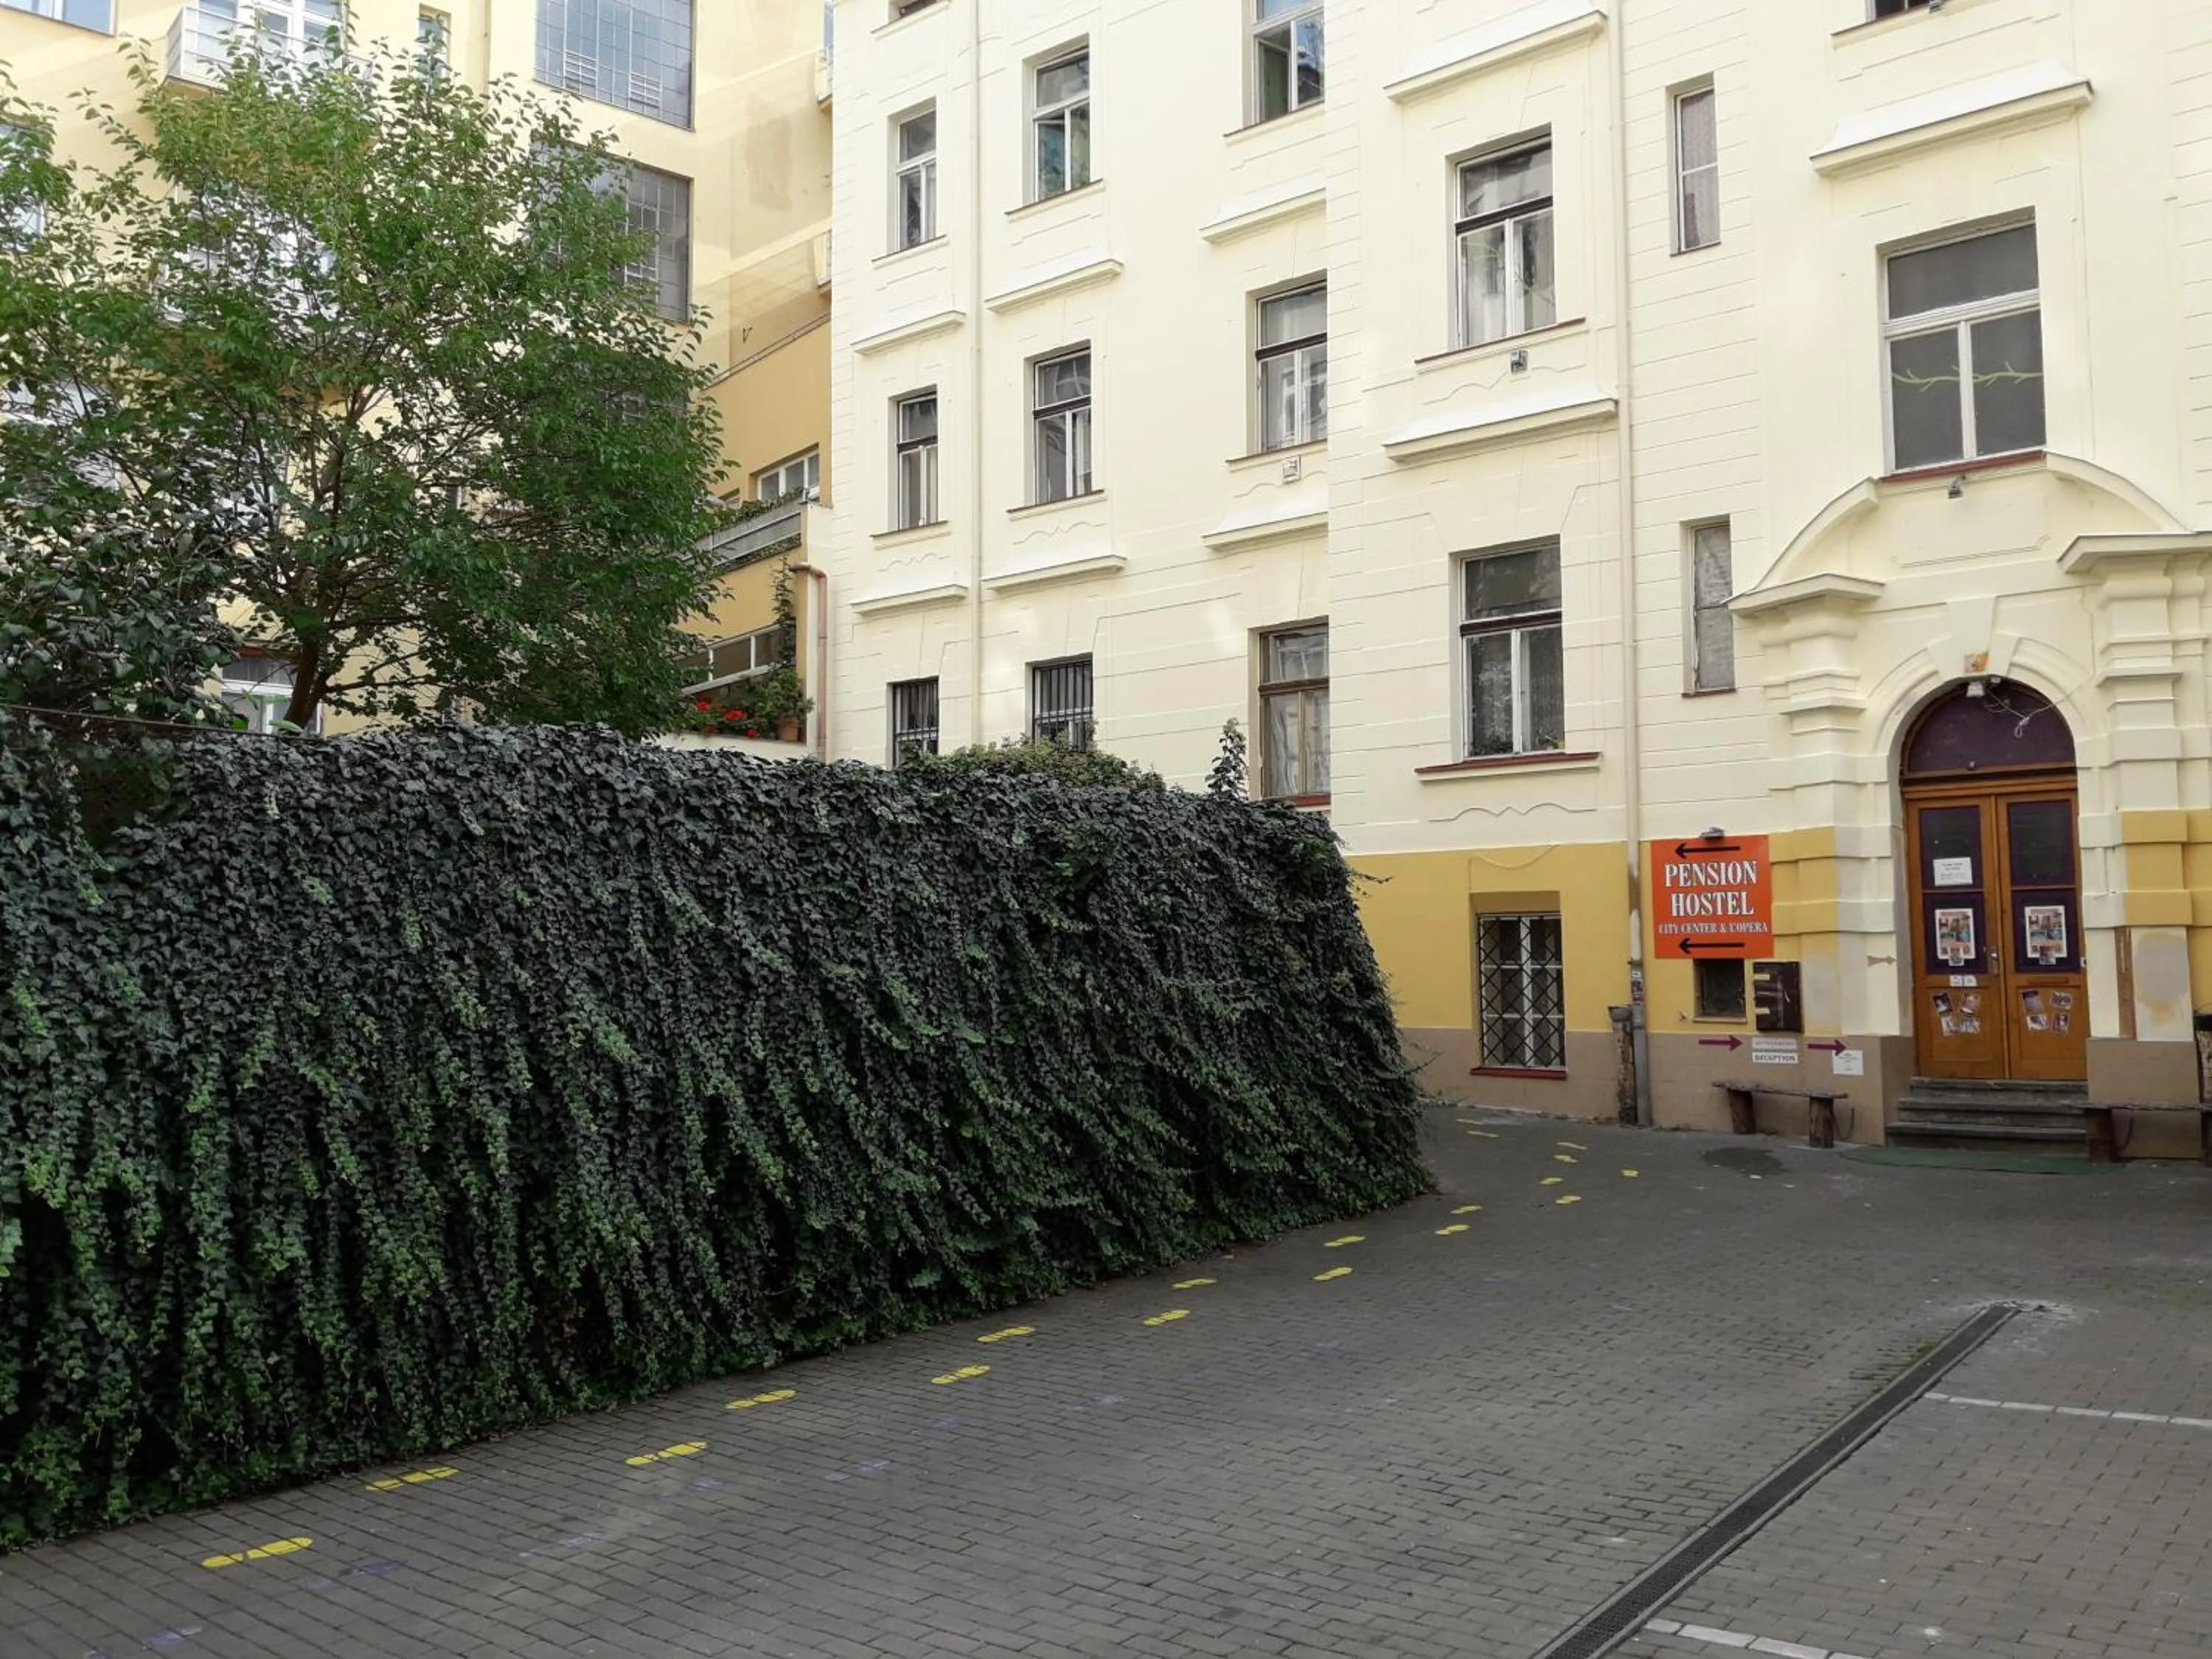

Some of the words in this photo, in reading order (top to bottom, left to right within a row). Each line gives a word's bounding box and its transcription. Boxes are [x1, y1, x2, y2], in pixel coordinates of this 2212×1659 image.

[1664, 860, 1758, 887] PENSION
[1671, 891, 1754, 917] HOSTEL
[1659, 922, 1678, 934] CITY
[1680, 922, 1717, 933] CENTER
[1720, 922, 1727, 933] &
